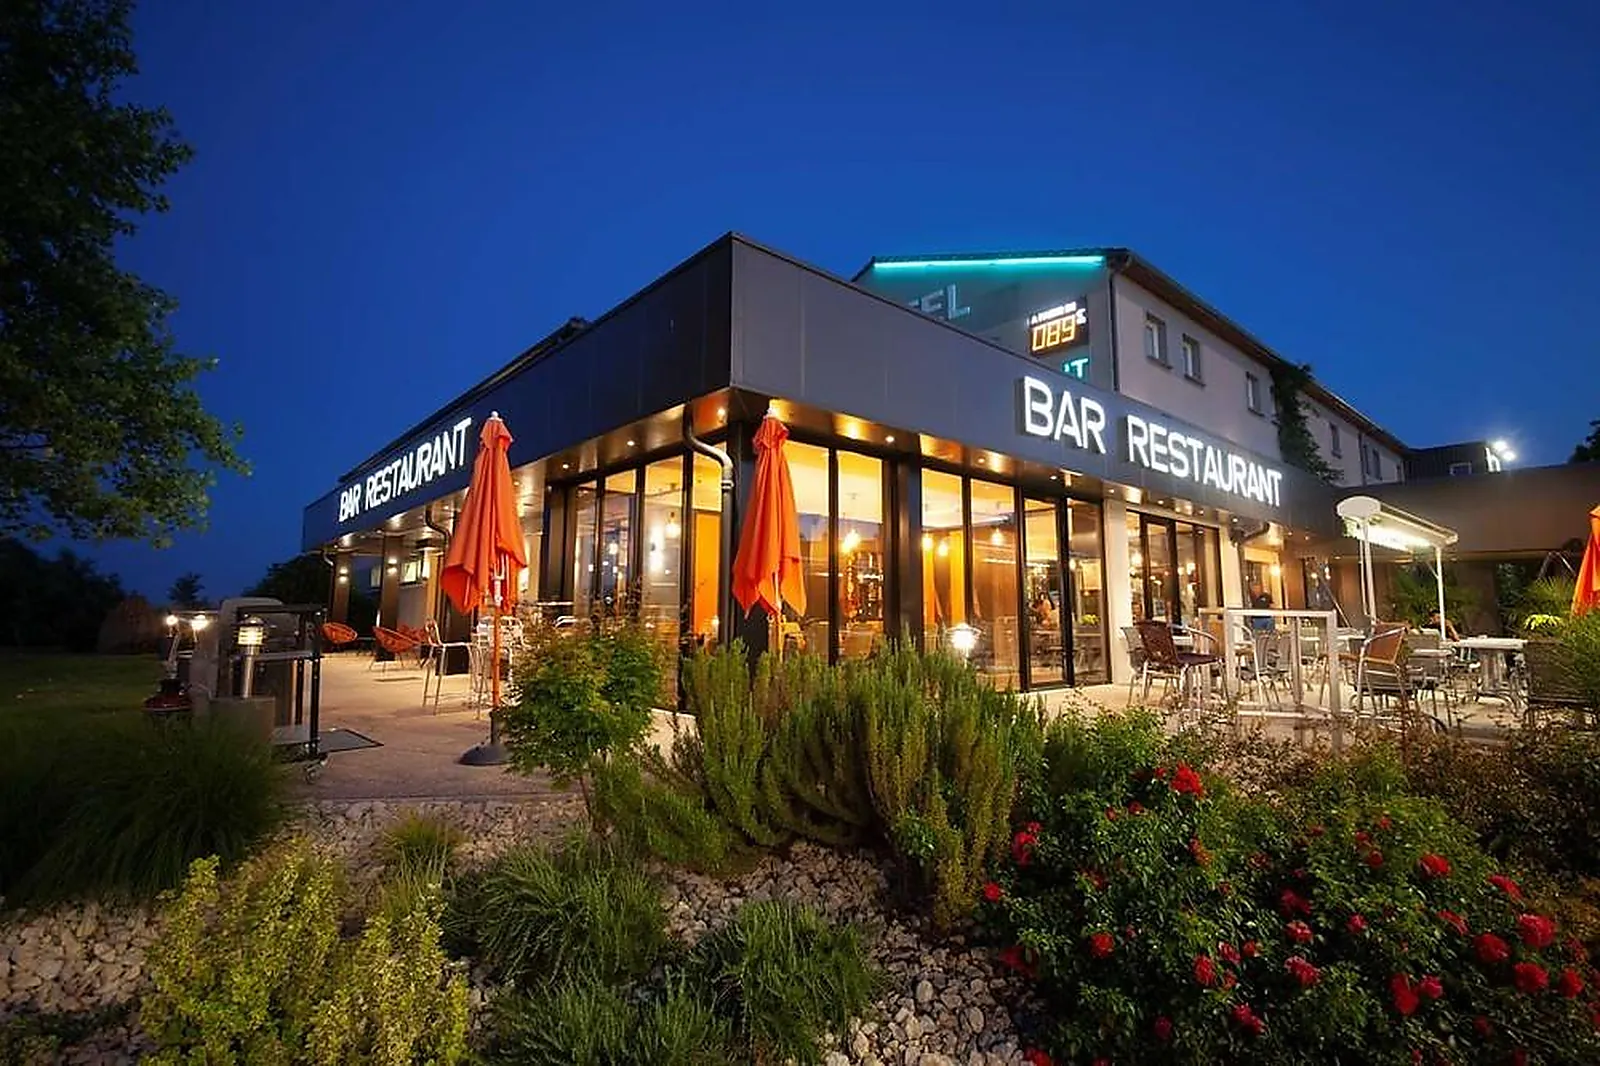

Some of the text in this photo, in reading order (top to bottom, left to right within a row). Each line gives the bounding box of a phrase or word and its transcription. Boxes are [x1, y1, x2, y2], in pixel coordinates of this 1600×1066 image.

[908, 283, 971, 320] EL
[1032, 314, 1076, 351] 089
[338, 417, 472, 522] BAR RESTAURANT
[1024, 375, 1282, 507] BAR RESTAURANT
